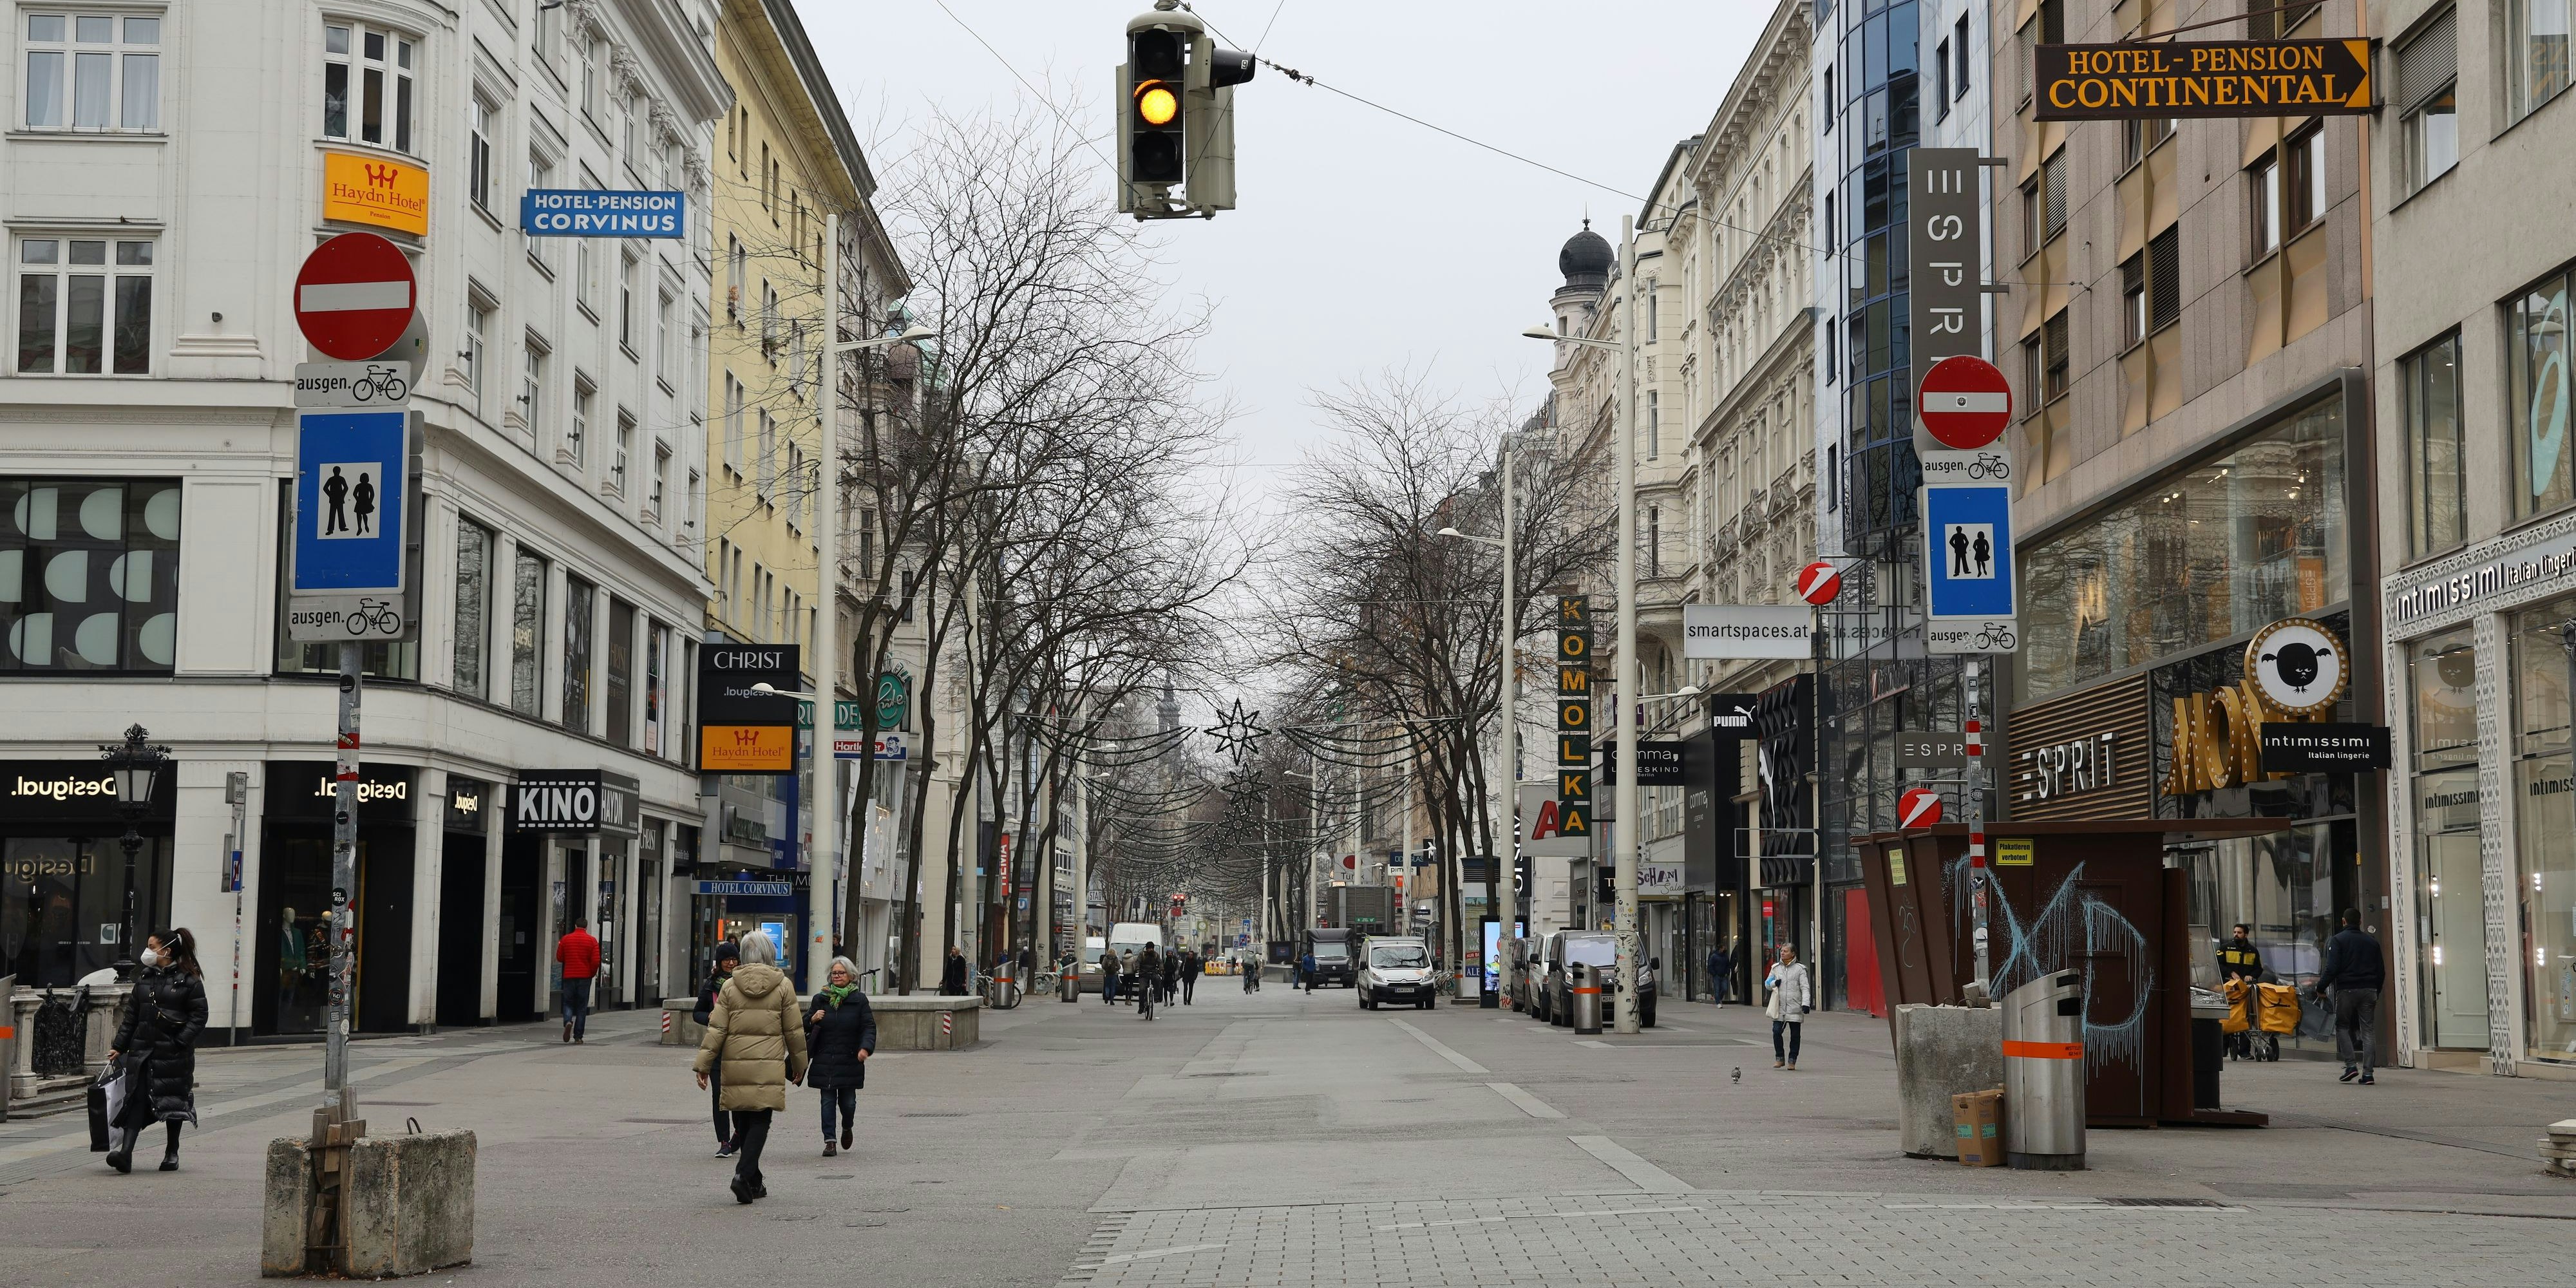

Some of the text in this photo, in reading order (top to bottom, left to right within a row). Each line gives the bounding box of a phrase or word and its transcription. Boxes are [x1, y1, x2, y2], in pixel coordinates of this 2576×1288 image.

[2049, 74, 2348, 109] CONTINENTAL
[332, 182, 385, 204] Haydn
[535, 194, 676, 211] HOTEL-PENSION
[369, 211, 391, 220] Pension
[534, 213, 676, 232] CORVINUS
[296, 374, 352, 393] ausgen.
[1924, 461, 1966, 473] ausgen.
[2396, 549, 2576, 621] intimissimi Italian lingeri
[291, 609, 345, 629] ausgen.
[1687, 623, 1808, 642] smartspaces.at
[713, 650, 783, 669] CHRIST
[1563, 600, 1586, 831] KOMOLKA
[1713, 715, 1747, 728] PUMA
[1905, 743, 1989, 757] ESPRT
[2265, 735, 2370, 747] intimissimi
[712, 746, 749, 759] Haydn
[1611, 750, 1679, 762] cmma,
[2307, 751, 2371, 761] Italian lingerie
[2022, 732, 2119, 801] ESPRIT
[2530, 777, 2574, 797] intimiss
[518, 787, 623, 825] KINO HAYDN
[1689, 790, 1708, 809] comma,
[2425, 790, 2479, 810] intimissimi
[1999, 843, 2031, 851] Plakatieren
[2002, 853, 2028, 862] verboten!
[710, 882, 788, 895] HOTEL CORVINUS
